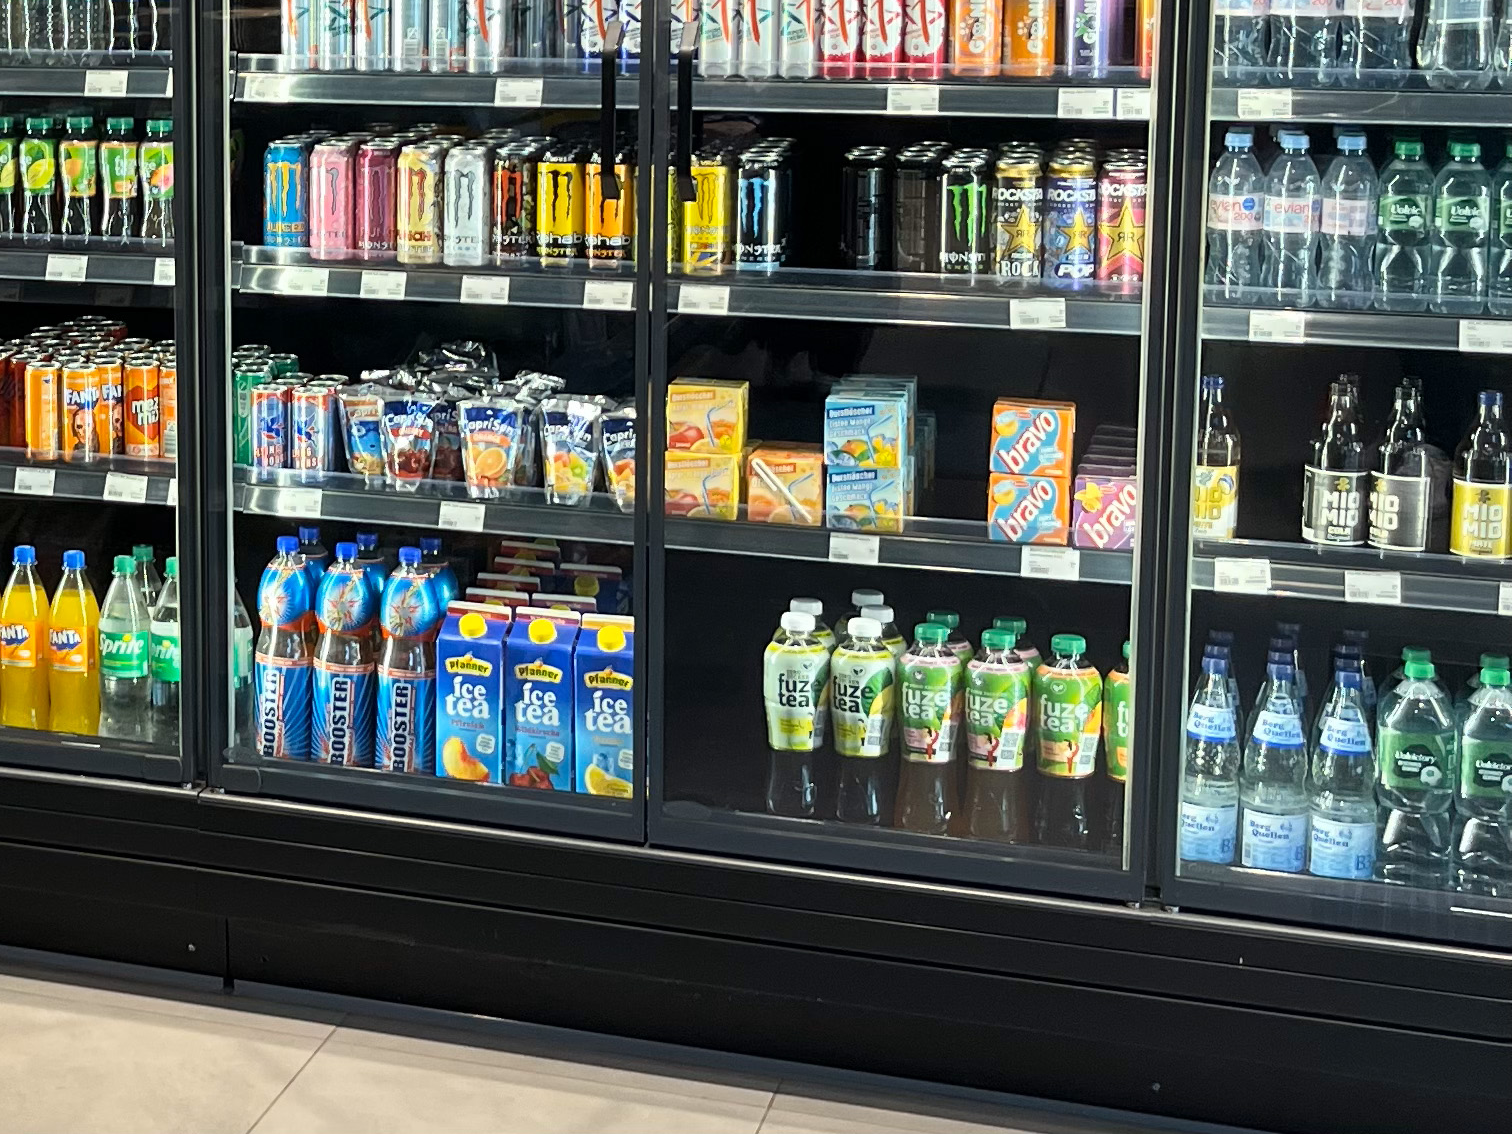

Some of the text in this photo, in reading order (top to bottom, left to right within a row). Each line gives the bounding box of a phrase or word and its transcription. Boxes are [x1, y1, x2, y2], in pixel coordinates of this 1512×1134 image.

[998, 412, 1056, 475] bravo
[999, 480, 1054, 545] bravo
[1321, 490, 1360, 511] MIO
[1463, 503, 1503, 523] MIO
[1086, 483, 1137, 550] bravo
[1321, 508, 1360, 527] MIO
[1462, 520, 1502, 540] MIO
[0, 624, 30, 643] FANTA
[49, 628, 82, 647] FANTA
[99, 631, 144, 657] Sprite
[453, 676, 487, 701] ice
[522, 682, 558, 707] ice
[833, 675, 875, 700] fuze
[901, 681, 950, 707] fuze
[965, 686, 1008, 714] fuze
[445, 695, 491, 719] tea
[514, 700, 561, 727] tea
[592, 690, 629, 715] ice
[833, 695, 861, 714] tea
[901, 699, 935, 721] tea
[1040, 694, 1089, 721] fuze
[330, 677, 351, 766] BOOSTER
[391, 682, 412, 772] BOOSTER
[584, 708, 634, 735] tea
[965, 707, 998, 729] tea
[1040, 713, 1074, 734] tea
